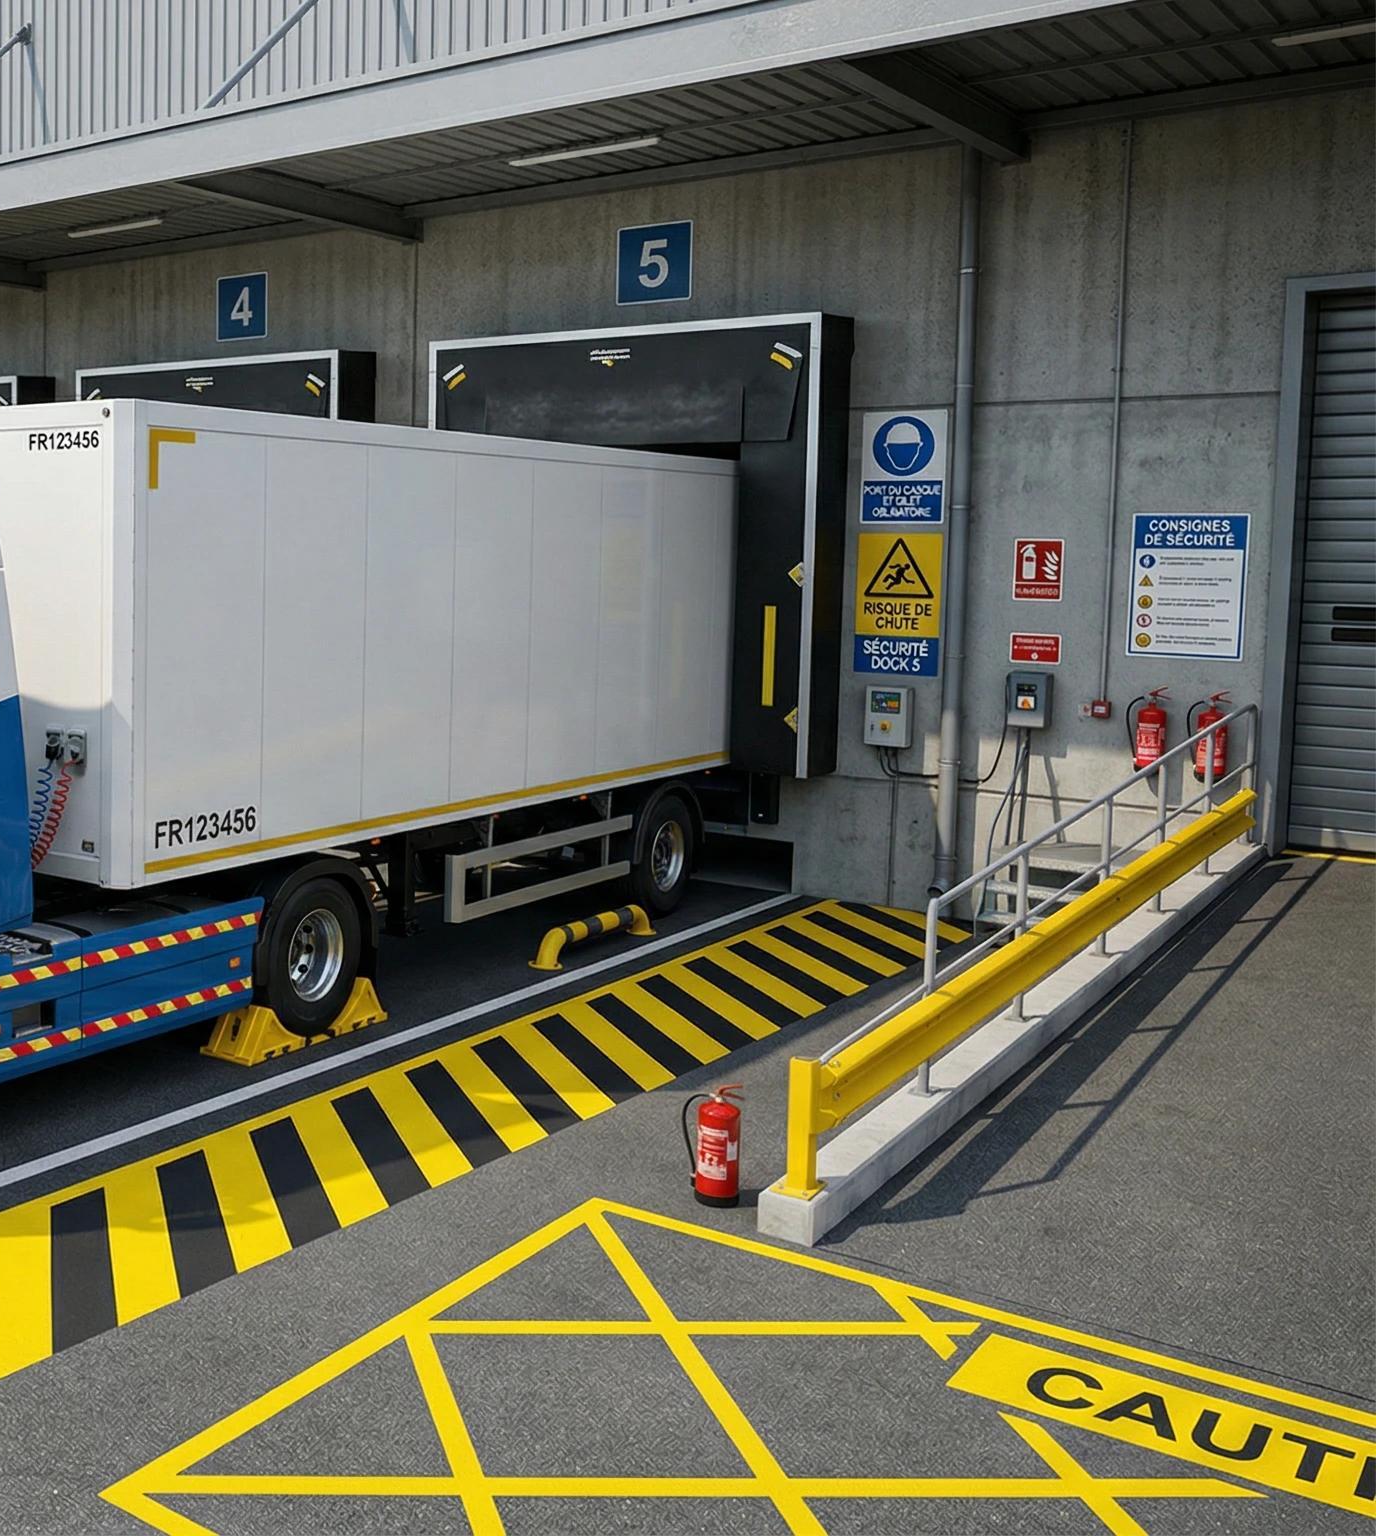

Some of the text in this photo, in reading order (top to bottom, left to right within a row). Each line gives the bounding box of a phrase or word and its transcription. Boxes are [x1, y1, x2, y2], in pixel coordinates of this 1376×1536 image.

[638, 238, 669, 288] 5
[230, 286, 253, 327] 4
[28, 430, 100, 451] FR123456
[888, 485, 902, 495] DU
[1149, 520, 1231, 532] CONSIGNES
[1165, 532, 1235, 546] SÉCURITÉ
[864, 602, 932, 616] RISQUE DE
[875, 617, 919, 630] CHUTE
[863, 637, 928, 656] SÉCURITÉ
[871, 655, 909, 671] DOCK
[155, 806, 256, 849] FR123456
